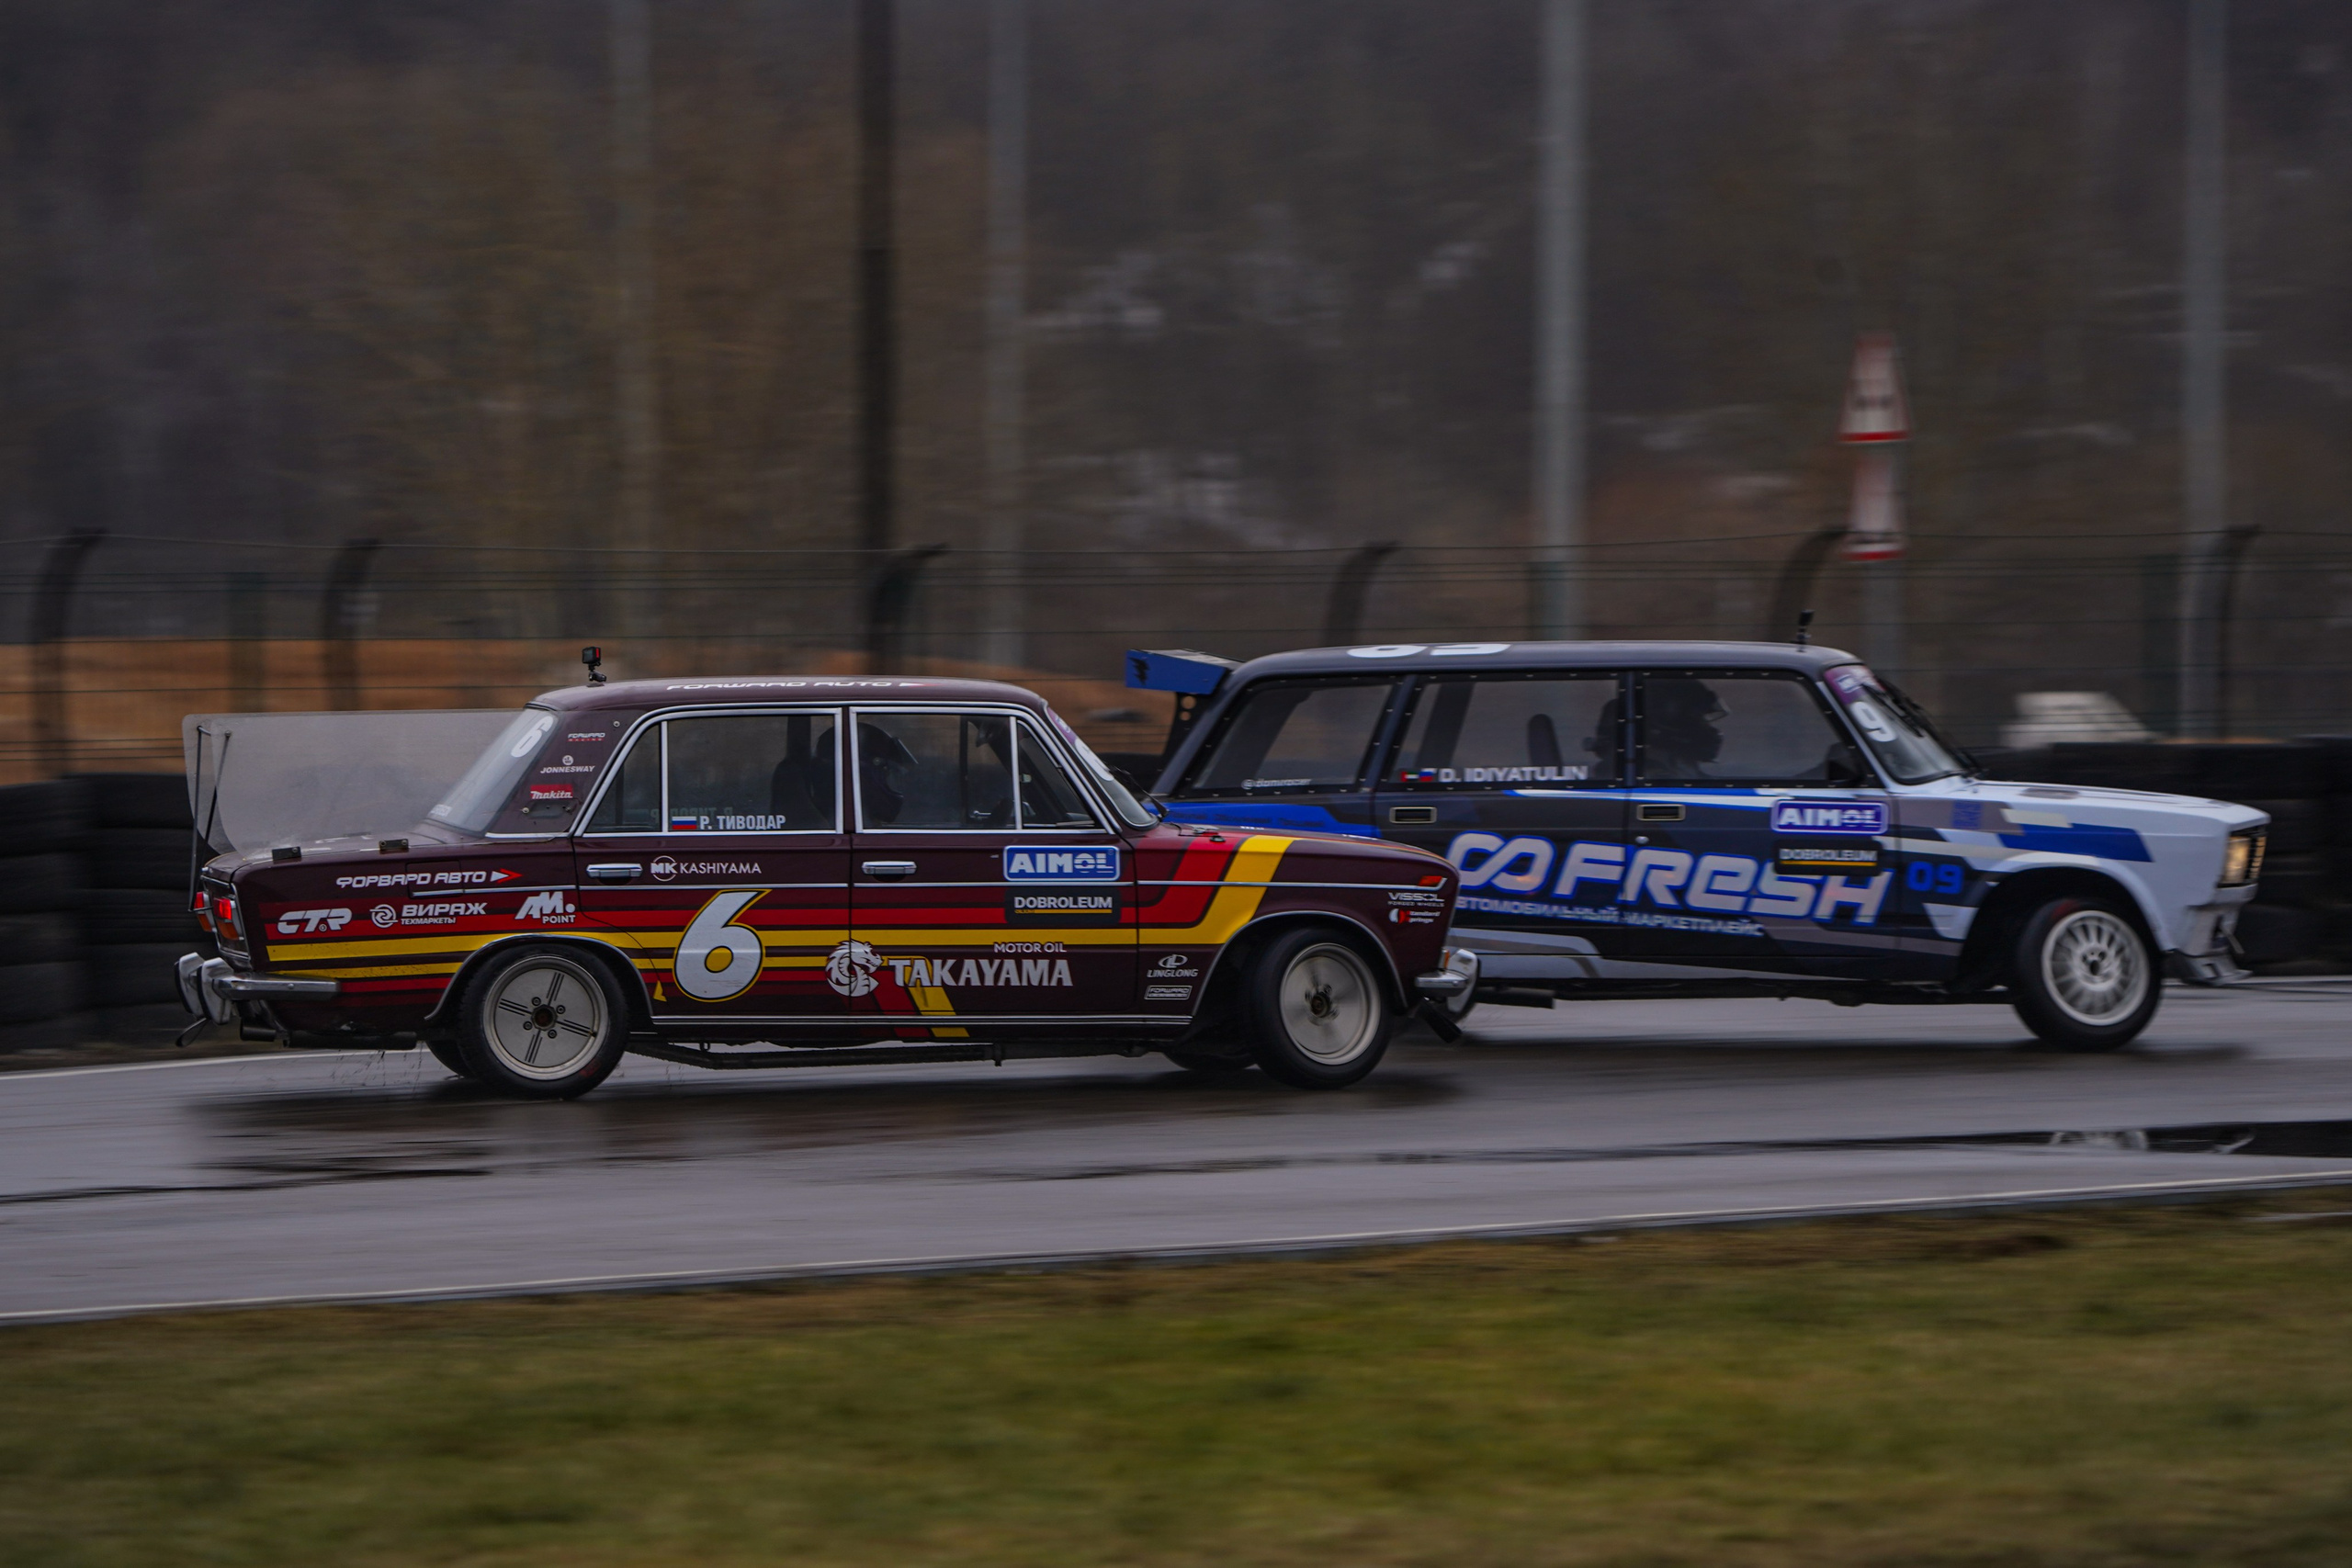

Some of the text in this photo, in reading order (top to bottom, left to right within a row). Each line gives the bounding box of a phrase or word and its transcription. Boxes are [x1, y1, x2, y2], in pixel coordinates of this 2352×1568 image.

[667, 682, 808, 690] FORWARD
[511, 716, 554, 758] 6
[540, 765, 595, 774] JONNESWAY
[1438, 765, 1589, 783] D. IDIYATULIN
[699, 815, 786, 830] Р. ТИВОДАР
[1779, 807, 1878, 828] AIMOL
[1009, 852, 1114, 874] AIMOL
[1779, 849, 1878, 862] DOBROLEUM
[650, 862, 763, 874] MK KASHIYAMA
[335, 871, 487, 889] ФОРВАРД АВТО
[1905, 861, 1964, 895] 09
[1013, 897, 1113, 908] DOBROLEUM
[1387, 891, 1445, 902] VISSOL
[401, 902, 488, 917] ВИРАЖ
[1454, 896, 1619, 924] ВТОМОБИЛЬНЫЙ
[277, 908, 353, 934] CTR
[401, 917, 457, 925] ТЕХМАРКЕТЫ
[542, 915, 576, 925] POINT
[673, 888, 773, 1003] 6
[993, 942, 1068, 953] MOTOR OIL
[888, 958, 1074, 987] TAKAYAMA
[1146, 968, 1199, 978] LINGLONG
